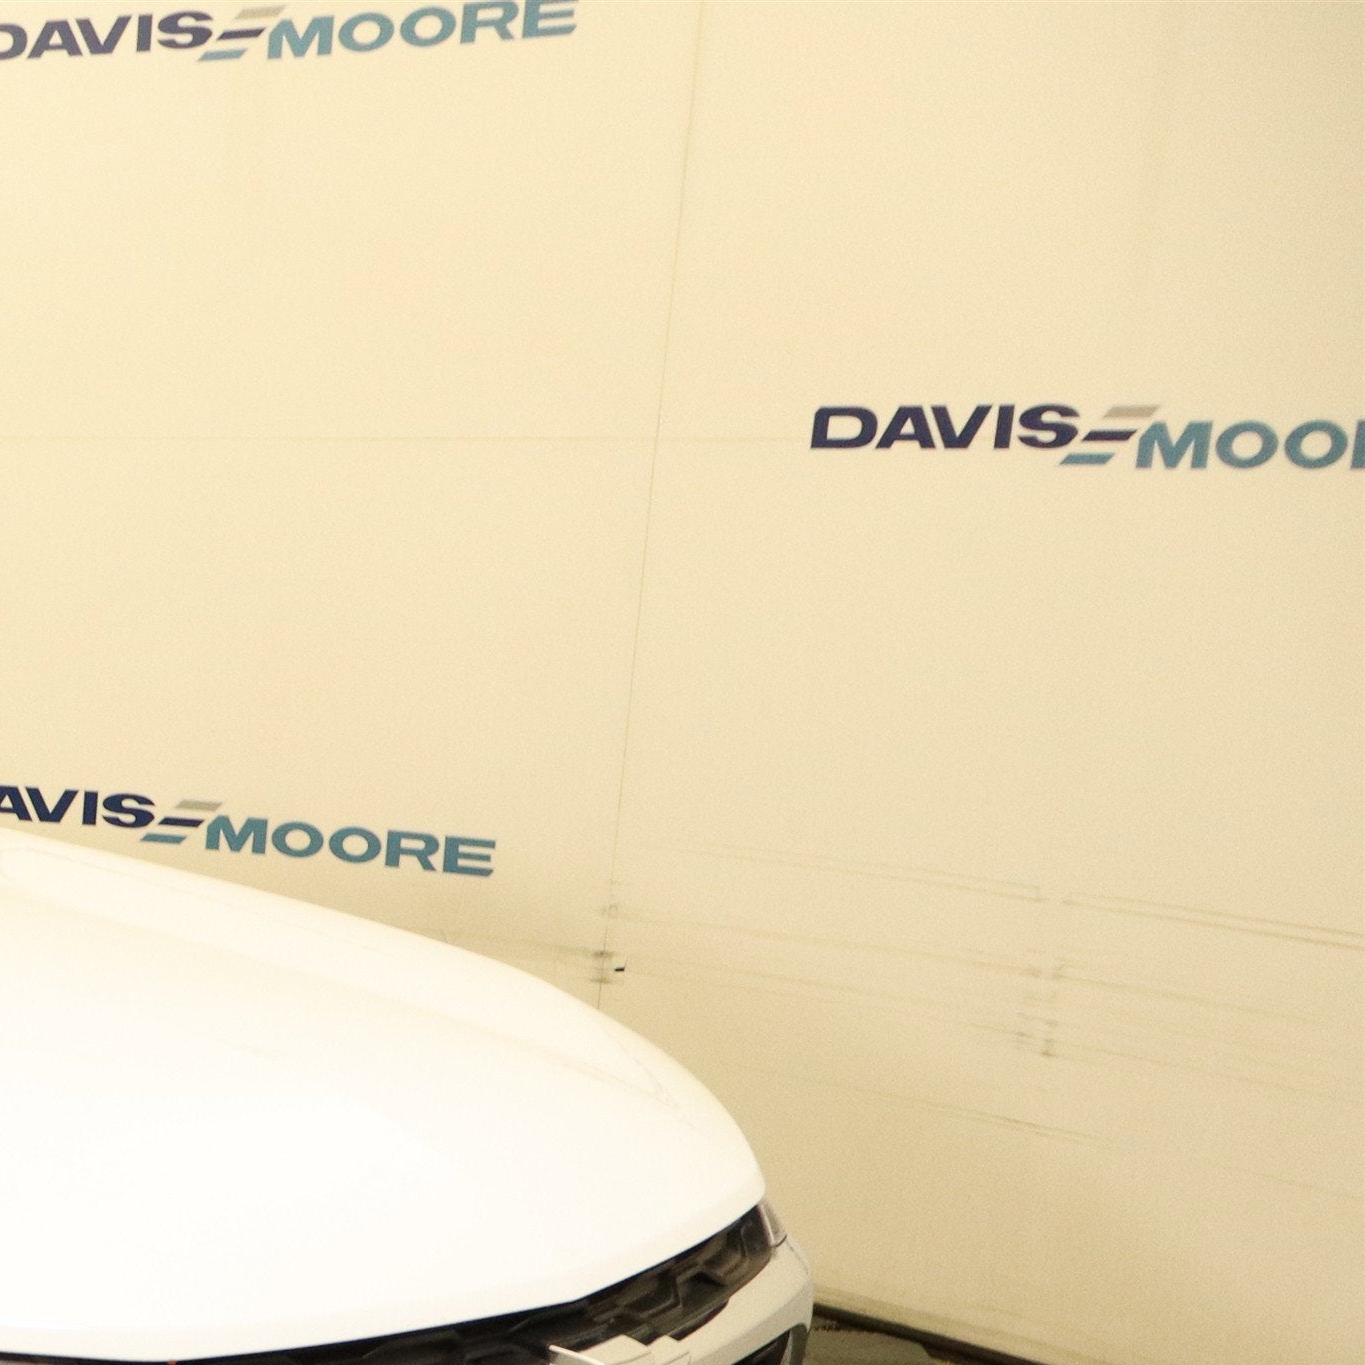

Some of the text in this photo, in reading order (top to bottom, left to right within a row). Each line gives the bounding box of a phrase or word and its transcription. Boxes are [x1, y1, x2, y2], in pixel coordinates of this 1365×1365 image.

[267, 0, 577, 60] MOORE
[810, 403, 1365, 470] DAVIS MOO
[205, 815, 497, 878] MOORE
